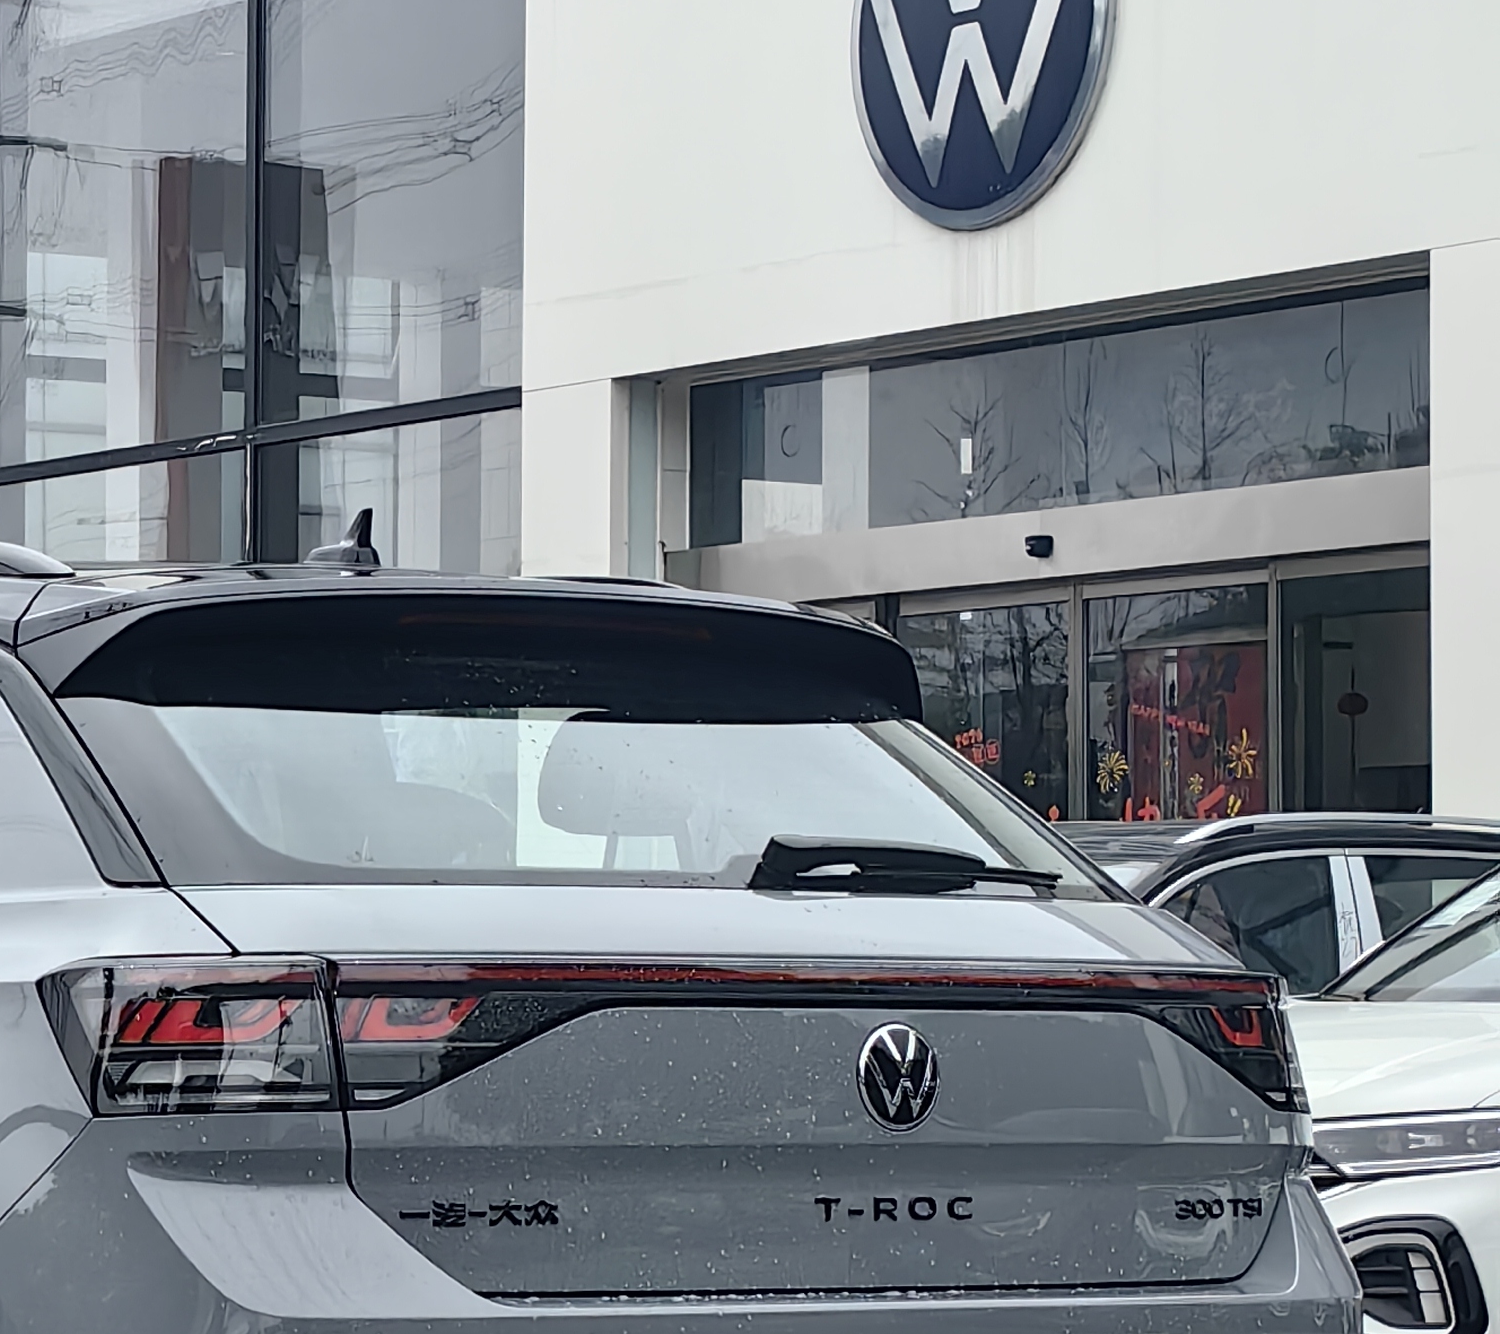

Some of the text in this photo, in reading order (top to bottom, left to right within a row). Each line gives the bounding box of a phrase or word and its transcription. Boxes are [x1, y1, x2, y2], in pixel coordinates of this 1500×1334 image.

[813, 1196, 974, 1222] T-ROC
[1174, 1197, 1263, 1221] 300 TSI
